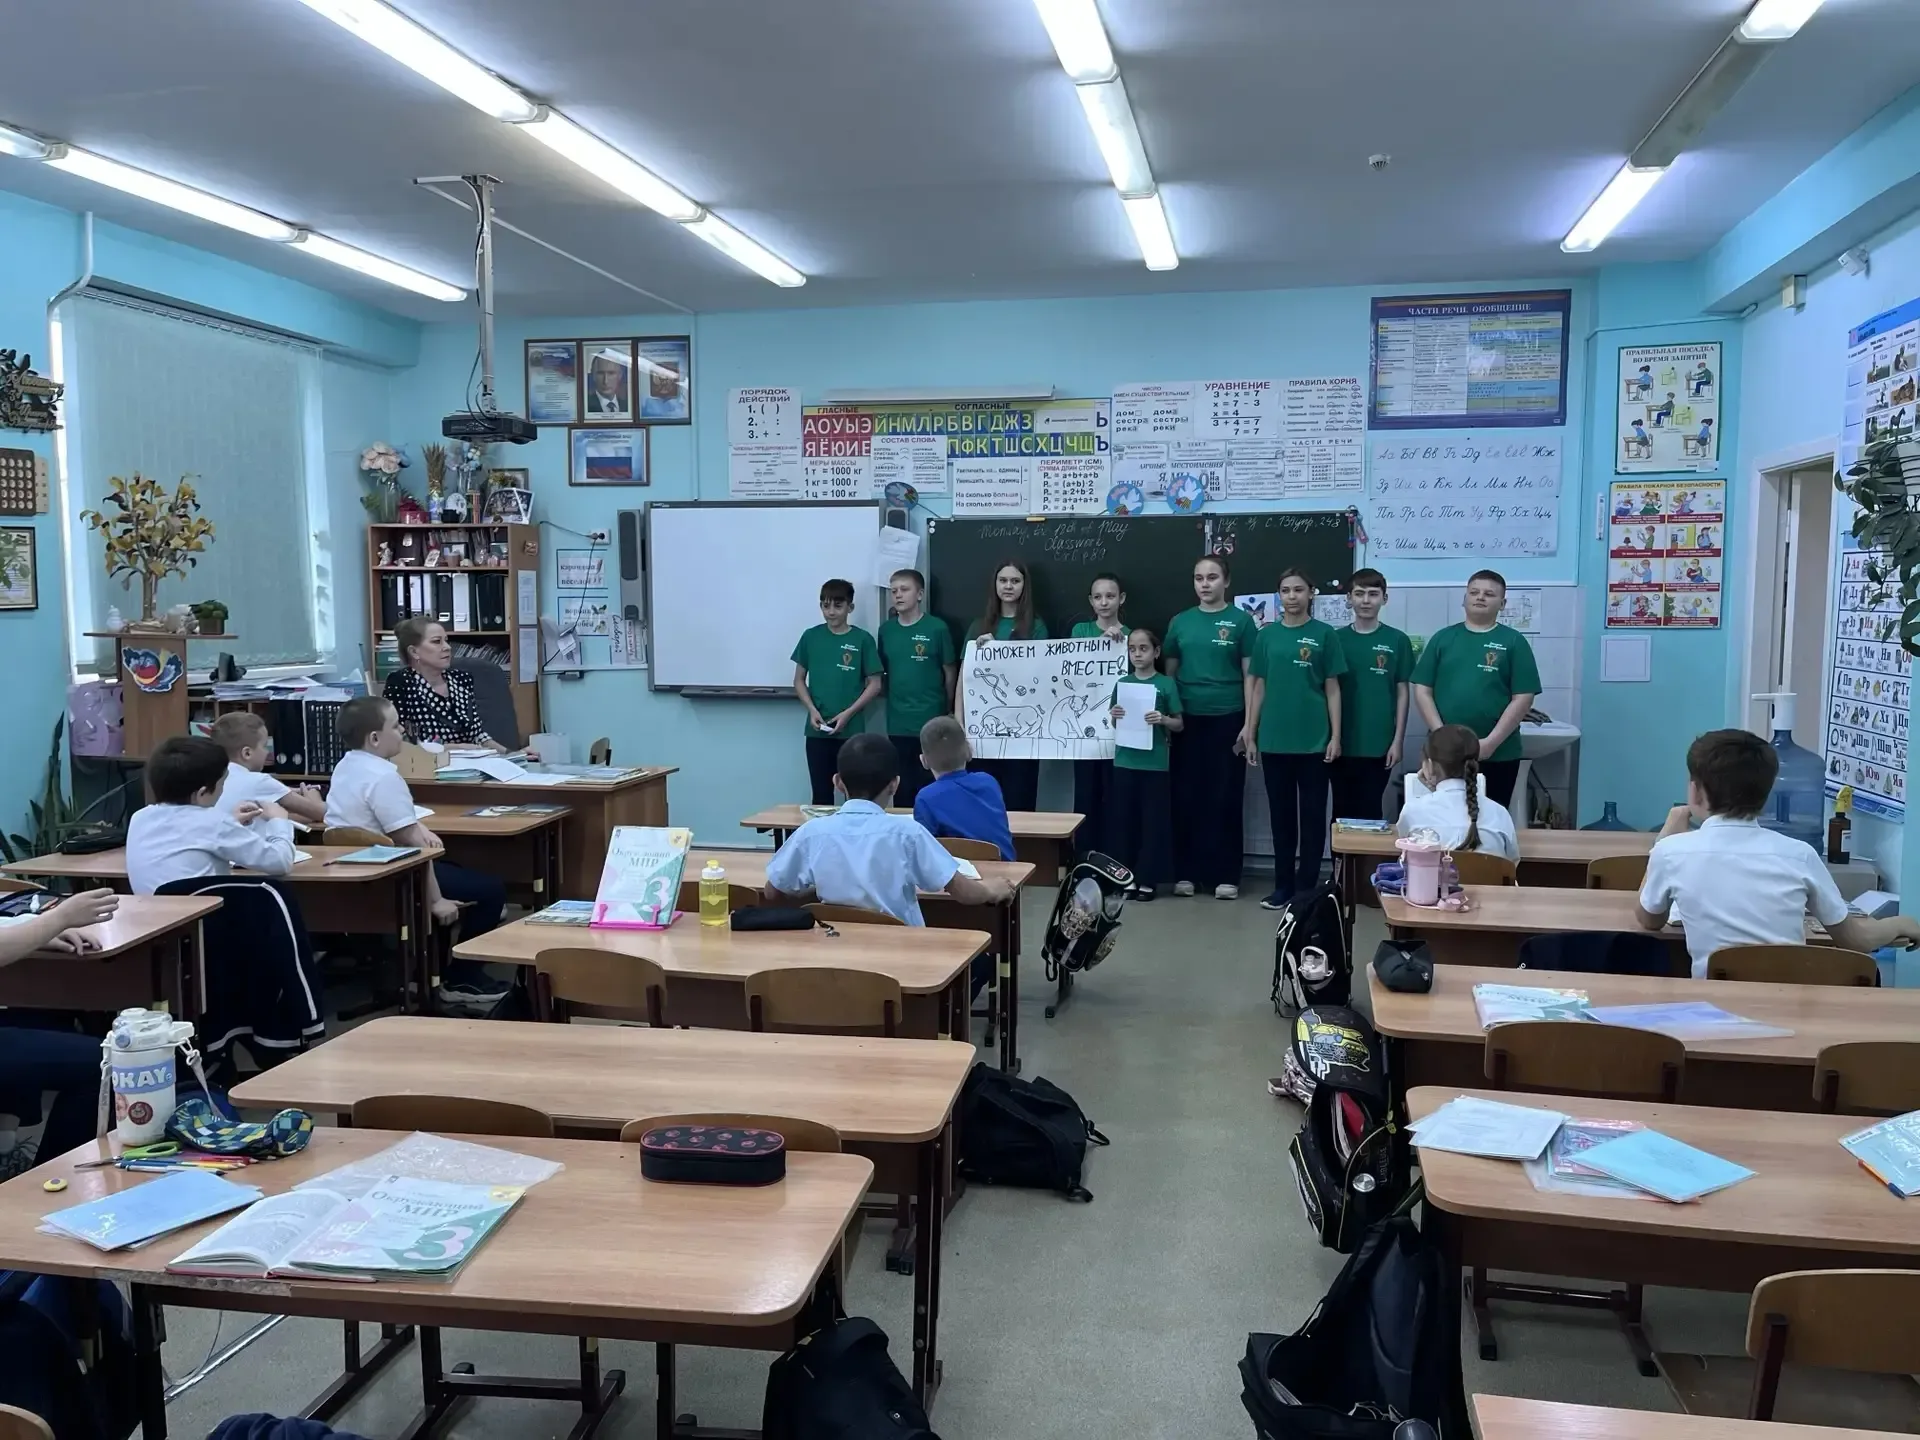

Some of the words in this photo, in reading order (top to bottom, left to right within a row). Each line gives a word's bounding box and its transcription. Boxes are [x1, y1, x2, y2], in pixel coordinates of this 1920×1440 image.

[1408, 307, 1439, 316] ЧАСТИ
[1472, 303, 1532, 313] ОБОБЩЕНИЕ
[1625, 348, 1677, 356] ПРАВИЛЬНАЯ
[1205, 381, 1271, 391] УРАВНЕНИЕ
[738, 396, 791, 404] ДЕЙСТВИЙ
[955, 402, 1011, 411] СОГЛАСНЫЕ
[1254, 399, 1260, 407] 3
[748, 405, 756, 414] 1.
[748, 417, 758, 426] 2.
[1097, 411, 1108, 428] Ь
[748, 430, 758, 439] 3.
[1097, 435, 1109, 452] Ъ
[1400, 447, 1418, 459] Бб
[1422, 446, 1439, 459] Вв
[1444, 447, 1457, 459] Гг
[1462, 447, 1480, 463] Дд
[1532, 445, 1556, 457] Жж
[804, 467, 809, 475] 1
[831, 467, 851, 475] 1000
[854, 468, 863, 476] кг
[804, 479, 809, 487] 1
[812, 480, 820, 488] кг
[831, 478, 851, 487] 1000
[1376, 478, 1389, 493] Зз
[1433, 476, 1452, 489] Кк
[1458, 477, 1478, 489] Лл
[1484, 476, 1508, 489] Мм
[1513, 476, 1533, 488] Нн
[804, 490, 809, 498] 1
[831, 490, 846, 498] 100
[1375, 506, 1395, 519] Пп
[1400, 506, 1416, 523] Рр
[1420, 506, 1434, 518] Сс
[1438, 505, 1465, 518] Тт
[1487, 505, 1506, 523] Фф
[1510, 506, 1529, 518] Хх
[1533, 506, 1552, 519] Цц
[1320, 516, 1341, 528] 248
[1098, 520, 1129, 541] May
[1374, 537, 1389, 550] Чч
[1395, 537, 1418, 550] Шш
[1424, 537, 1447, 550] Щщ
[975, 645, 1036, 661] ПОМОЖЕМ
[1045, 640, 1112, 656] ЖИВОТНЫМ
[1061, 655, 1128, 676] ВМЕСТЕ!
[1862, 676, 1870, 692] Рр
[1859, 706, 1870, 722] Фф
[1856, 733, 1869, 748] Шш
[1865, 766, 1880, 781] Юю
[1893, 774, 1903, 788] Яя
[629, 857, 659, 868] МИР
[648, 876, 671, 911] 3
[371, 1191, 484, 1210] Окружающий
[397, 1204, 459, 1217] МИР
[403, 1226, 474, 1260] 3
